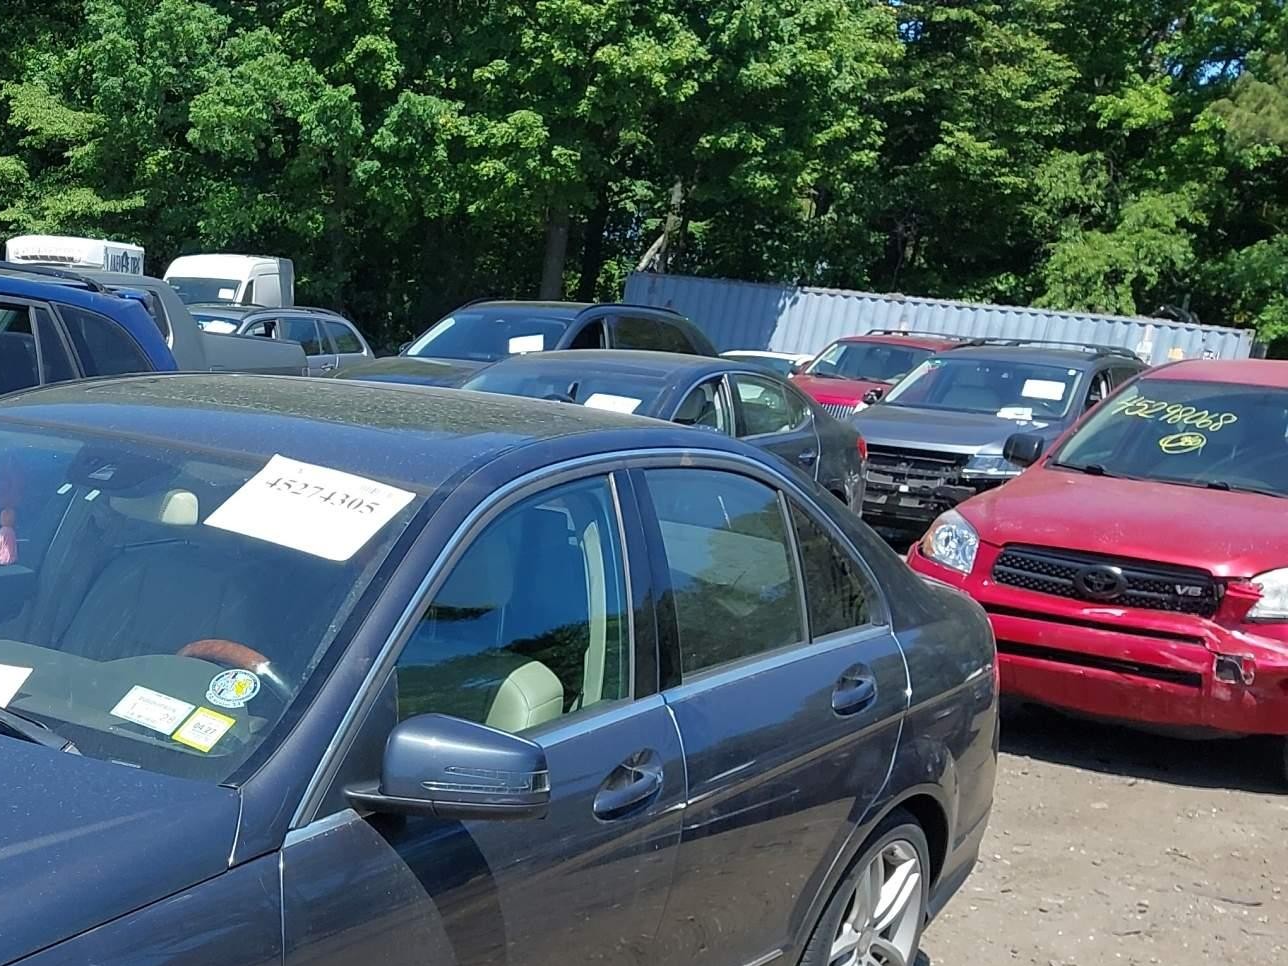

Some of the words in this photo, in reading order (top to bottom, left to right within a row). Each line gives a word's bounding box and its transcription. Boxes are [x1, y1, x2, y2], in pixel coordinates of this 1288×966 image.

[1112, 395, 1238, 432] 45298068
[266, 477, 380, 514] 45274305
[1175, 584, 1202, 597] V6
